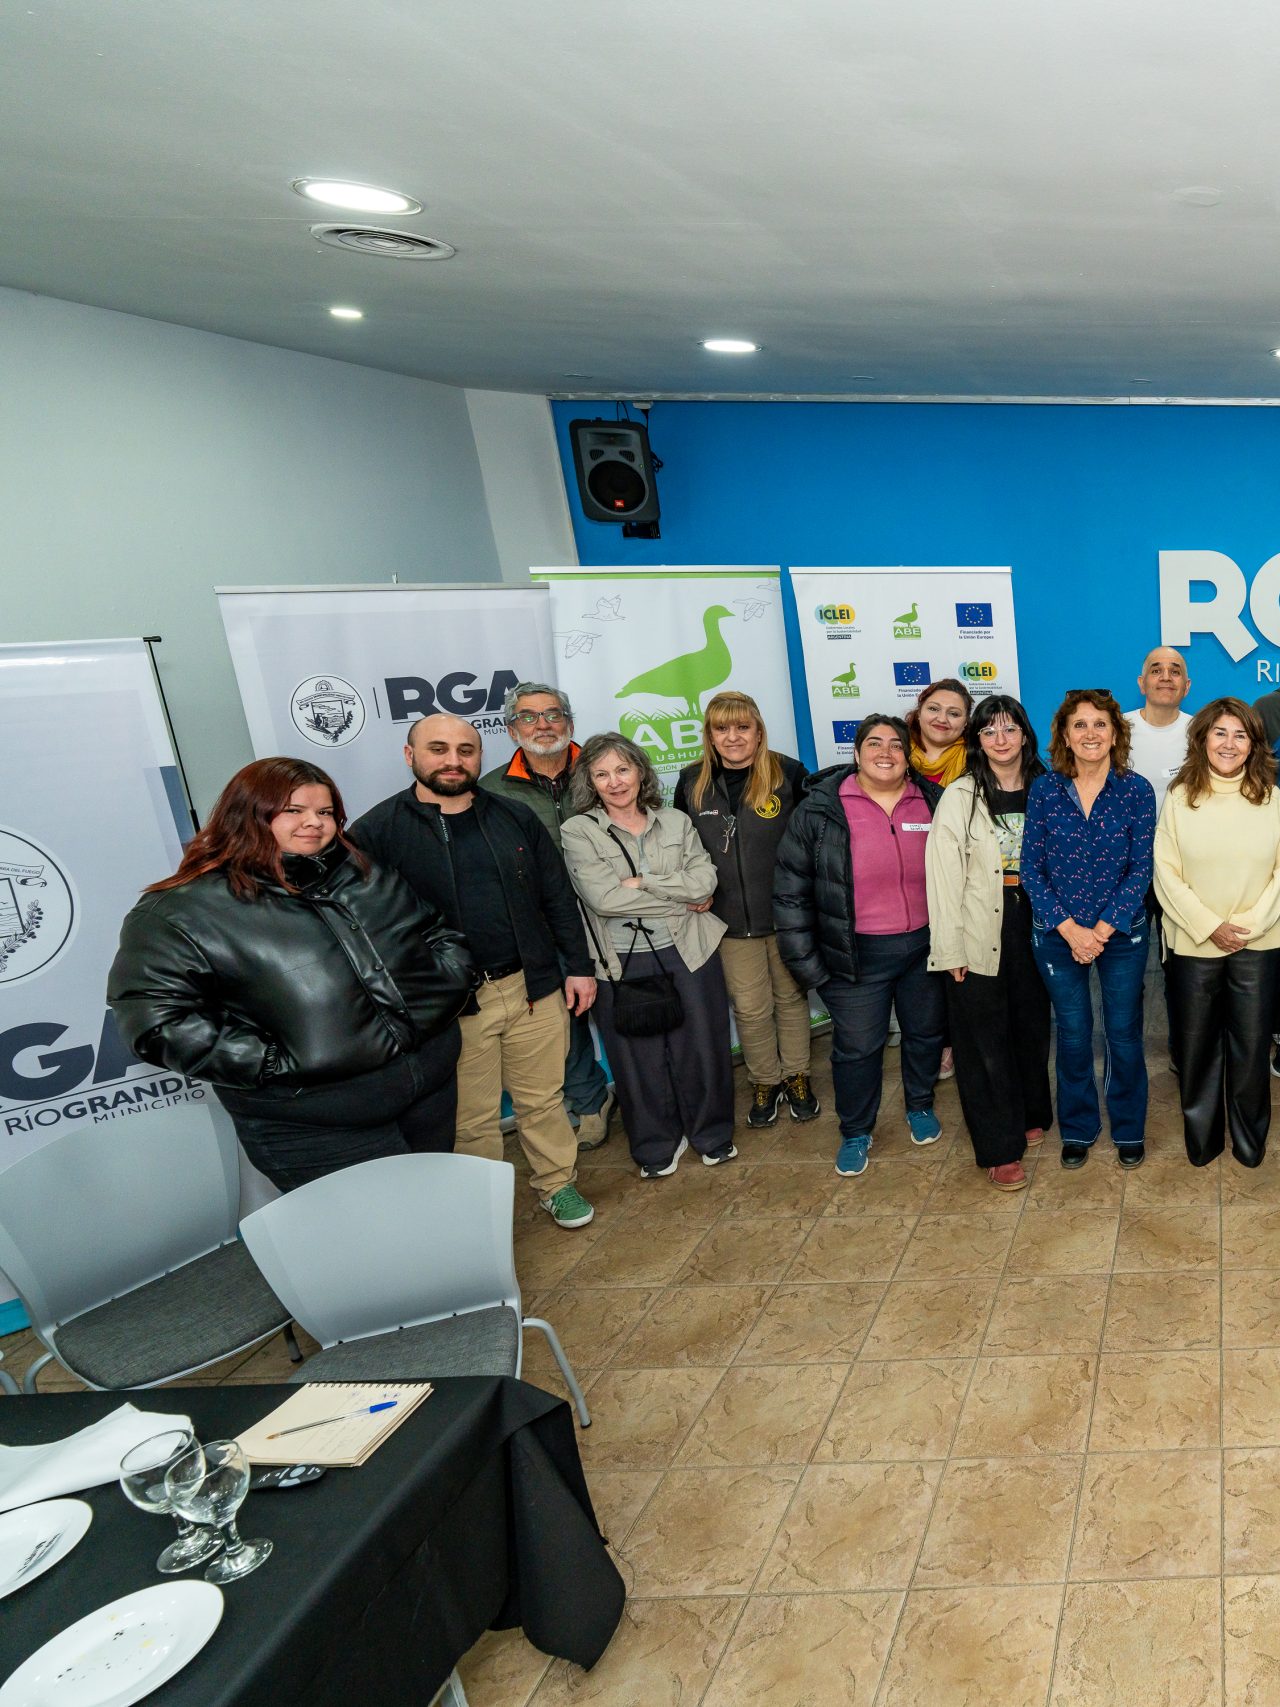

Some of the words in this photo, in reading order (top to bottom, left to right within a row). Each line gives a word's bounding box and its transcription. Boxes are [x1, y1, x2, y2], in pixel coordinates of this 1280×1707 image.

[819, 608, 850, 620] ICLEI
[895, 627, 920, 636] ABE
[963, 666, 992, 677] ICLEI
[384, 669, 520, 721] RGA
[833, 687, 859, 695] ABE
[632, 719, 704, 752] AB
